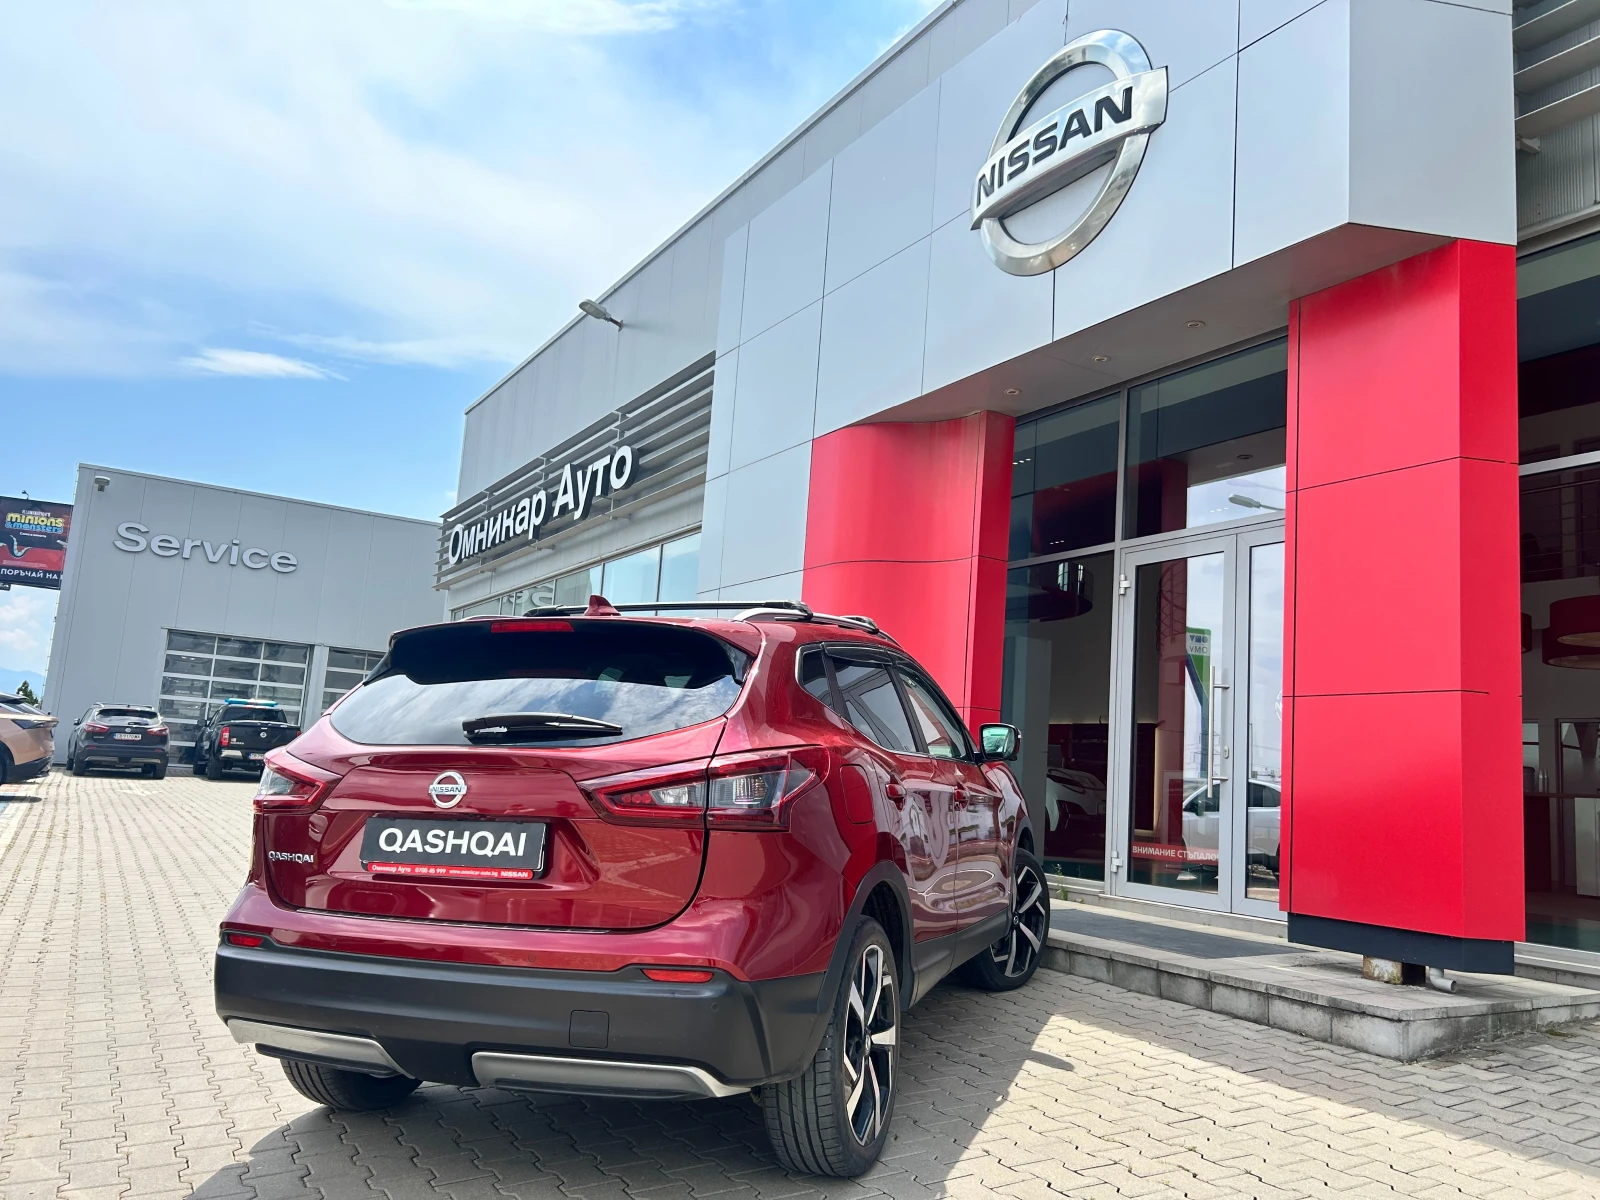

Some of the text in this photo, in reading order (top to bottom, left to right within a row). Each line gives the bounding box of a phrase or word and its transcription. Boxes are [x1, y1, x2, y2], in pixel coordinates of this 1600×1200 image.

[976, 86, 1133, 208] NISSAN
[449, 445, 635, 565] Омникар Ауто
[113, 521, 298, 573] Service
[0, 568, 44, 578] ПОРЪЧАЙ
[45, 572, 58, 580] НА
[268, 850, 314, 864] QASHQAI
[378, 827, 526, 857] QASHQAI
[1132, 845, 1176, 857] ВНИМАНИЕ
